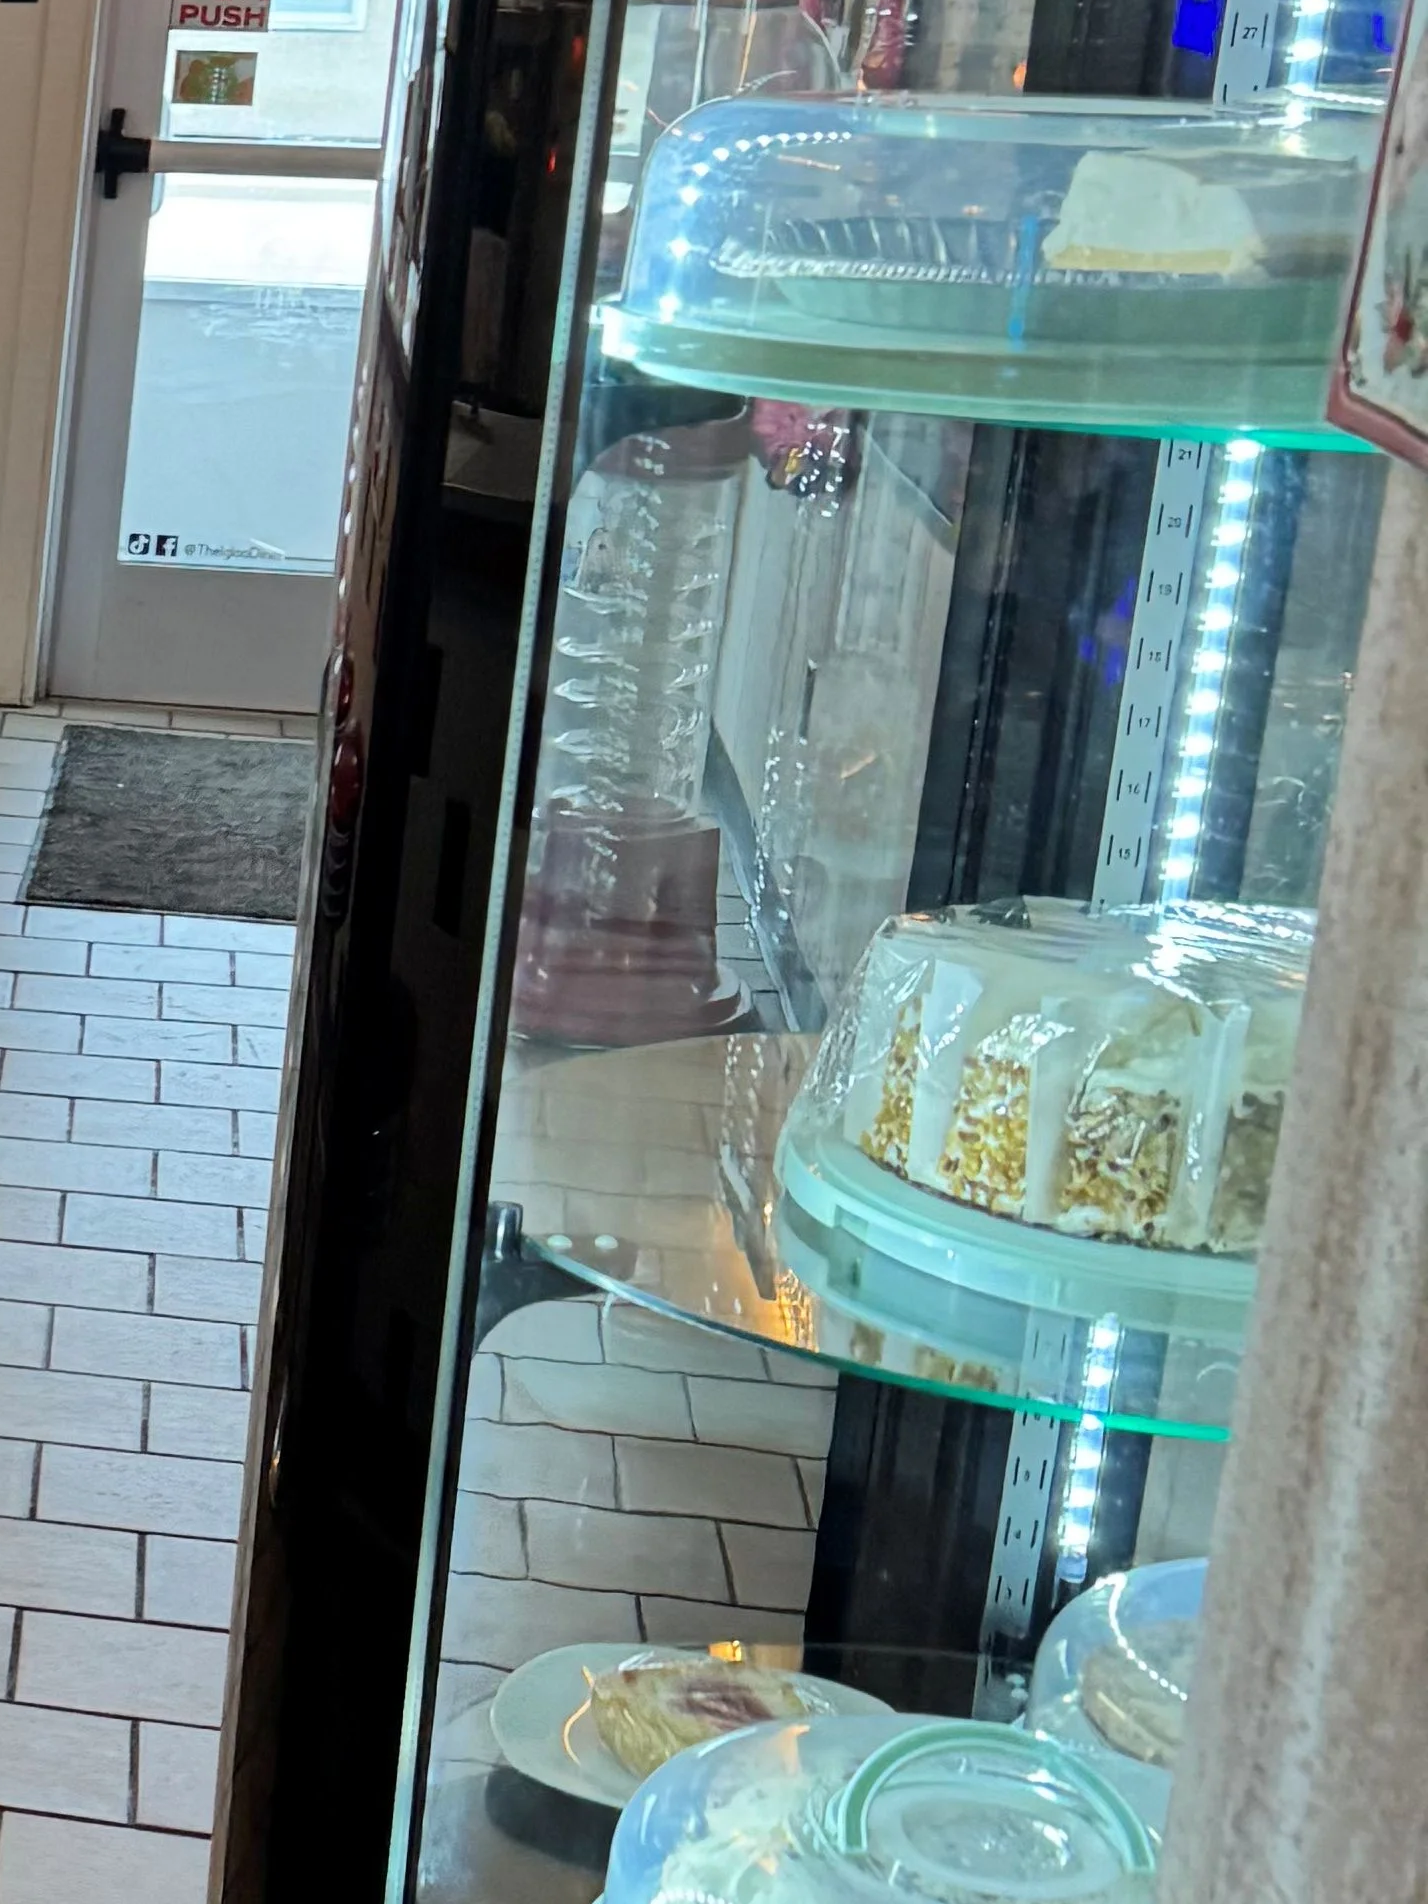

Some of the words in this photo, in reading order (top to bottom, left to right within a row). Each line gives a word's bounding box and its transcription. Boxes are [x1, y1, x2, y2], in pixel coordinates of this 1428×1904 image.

[178, 4, 266, 27] PUSH
[1242, 26, 1258, 40] 27
[1178, 449, 1193, 461] 21
[1138, 718, 1152, 729] 17
[1128, 783, 1141, 795] 16
[1118, 848, 1132, 860] 15
